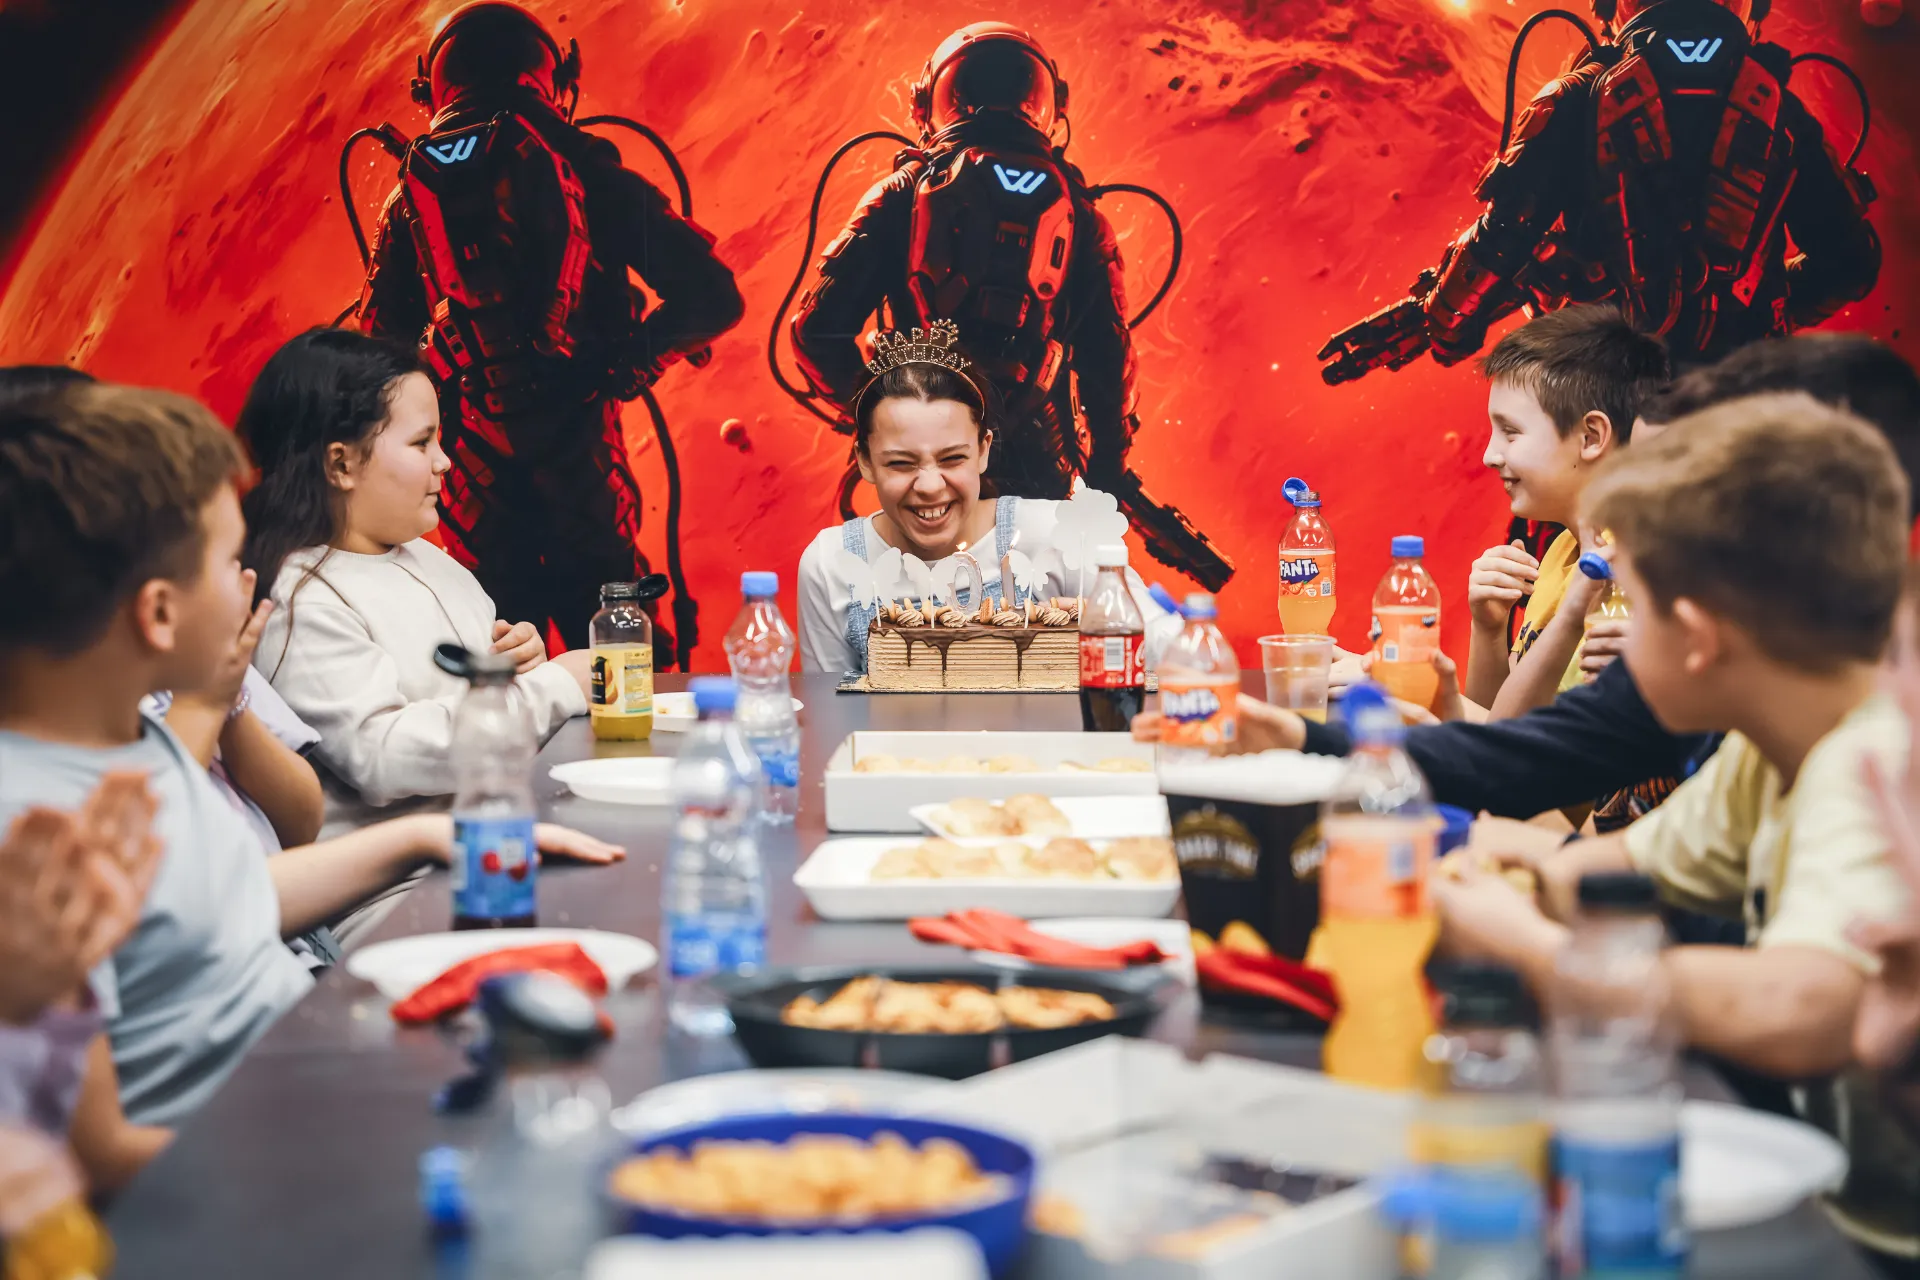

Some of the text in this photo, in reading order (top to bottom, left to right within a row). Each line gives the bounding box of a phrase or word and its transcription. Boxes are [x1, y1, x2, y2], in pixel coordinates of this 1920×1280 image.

[873, 327, 958, 353] HAPPY
[866, 346, 972, 375] BIRTHDAY
[1280, 559, 1319, 577] FANTA
